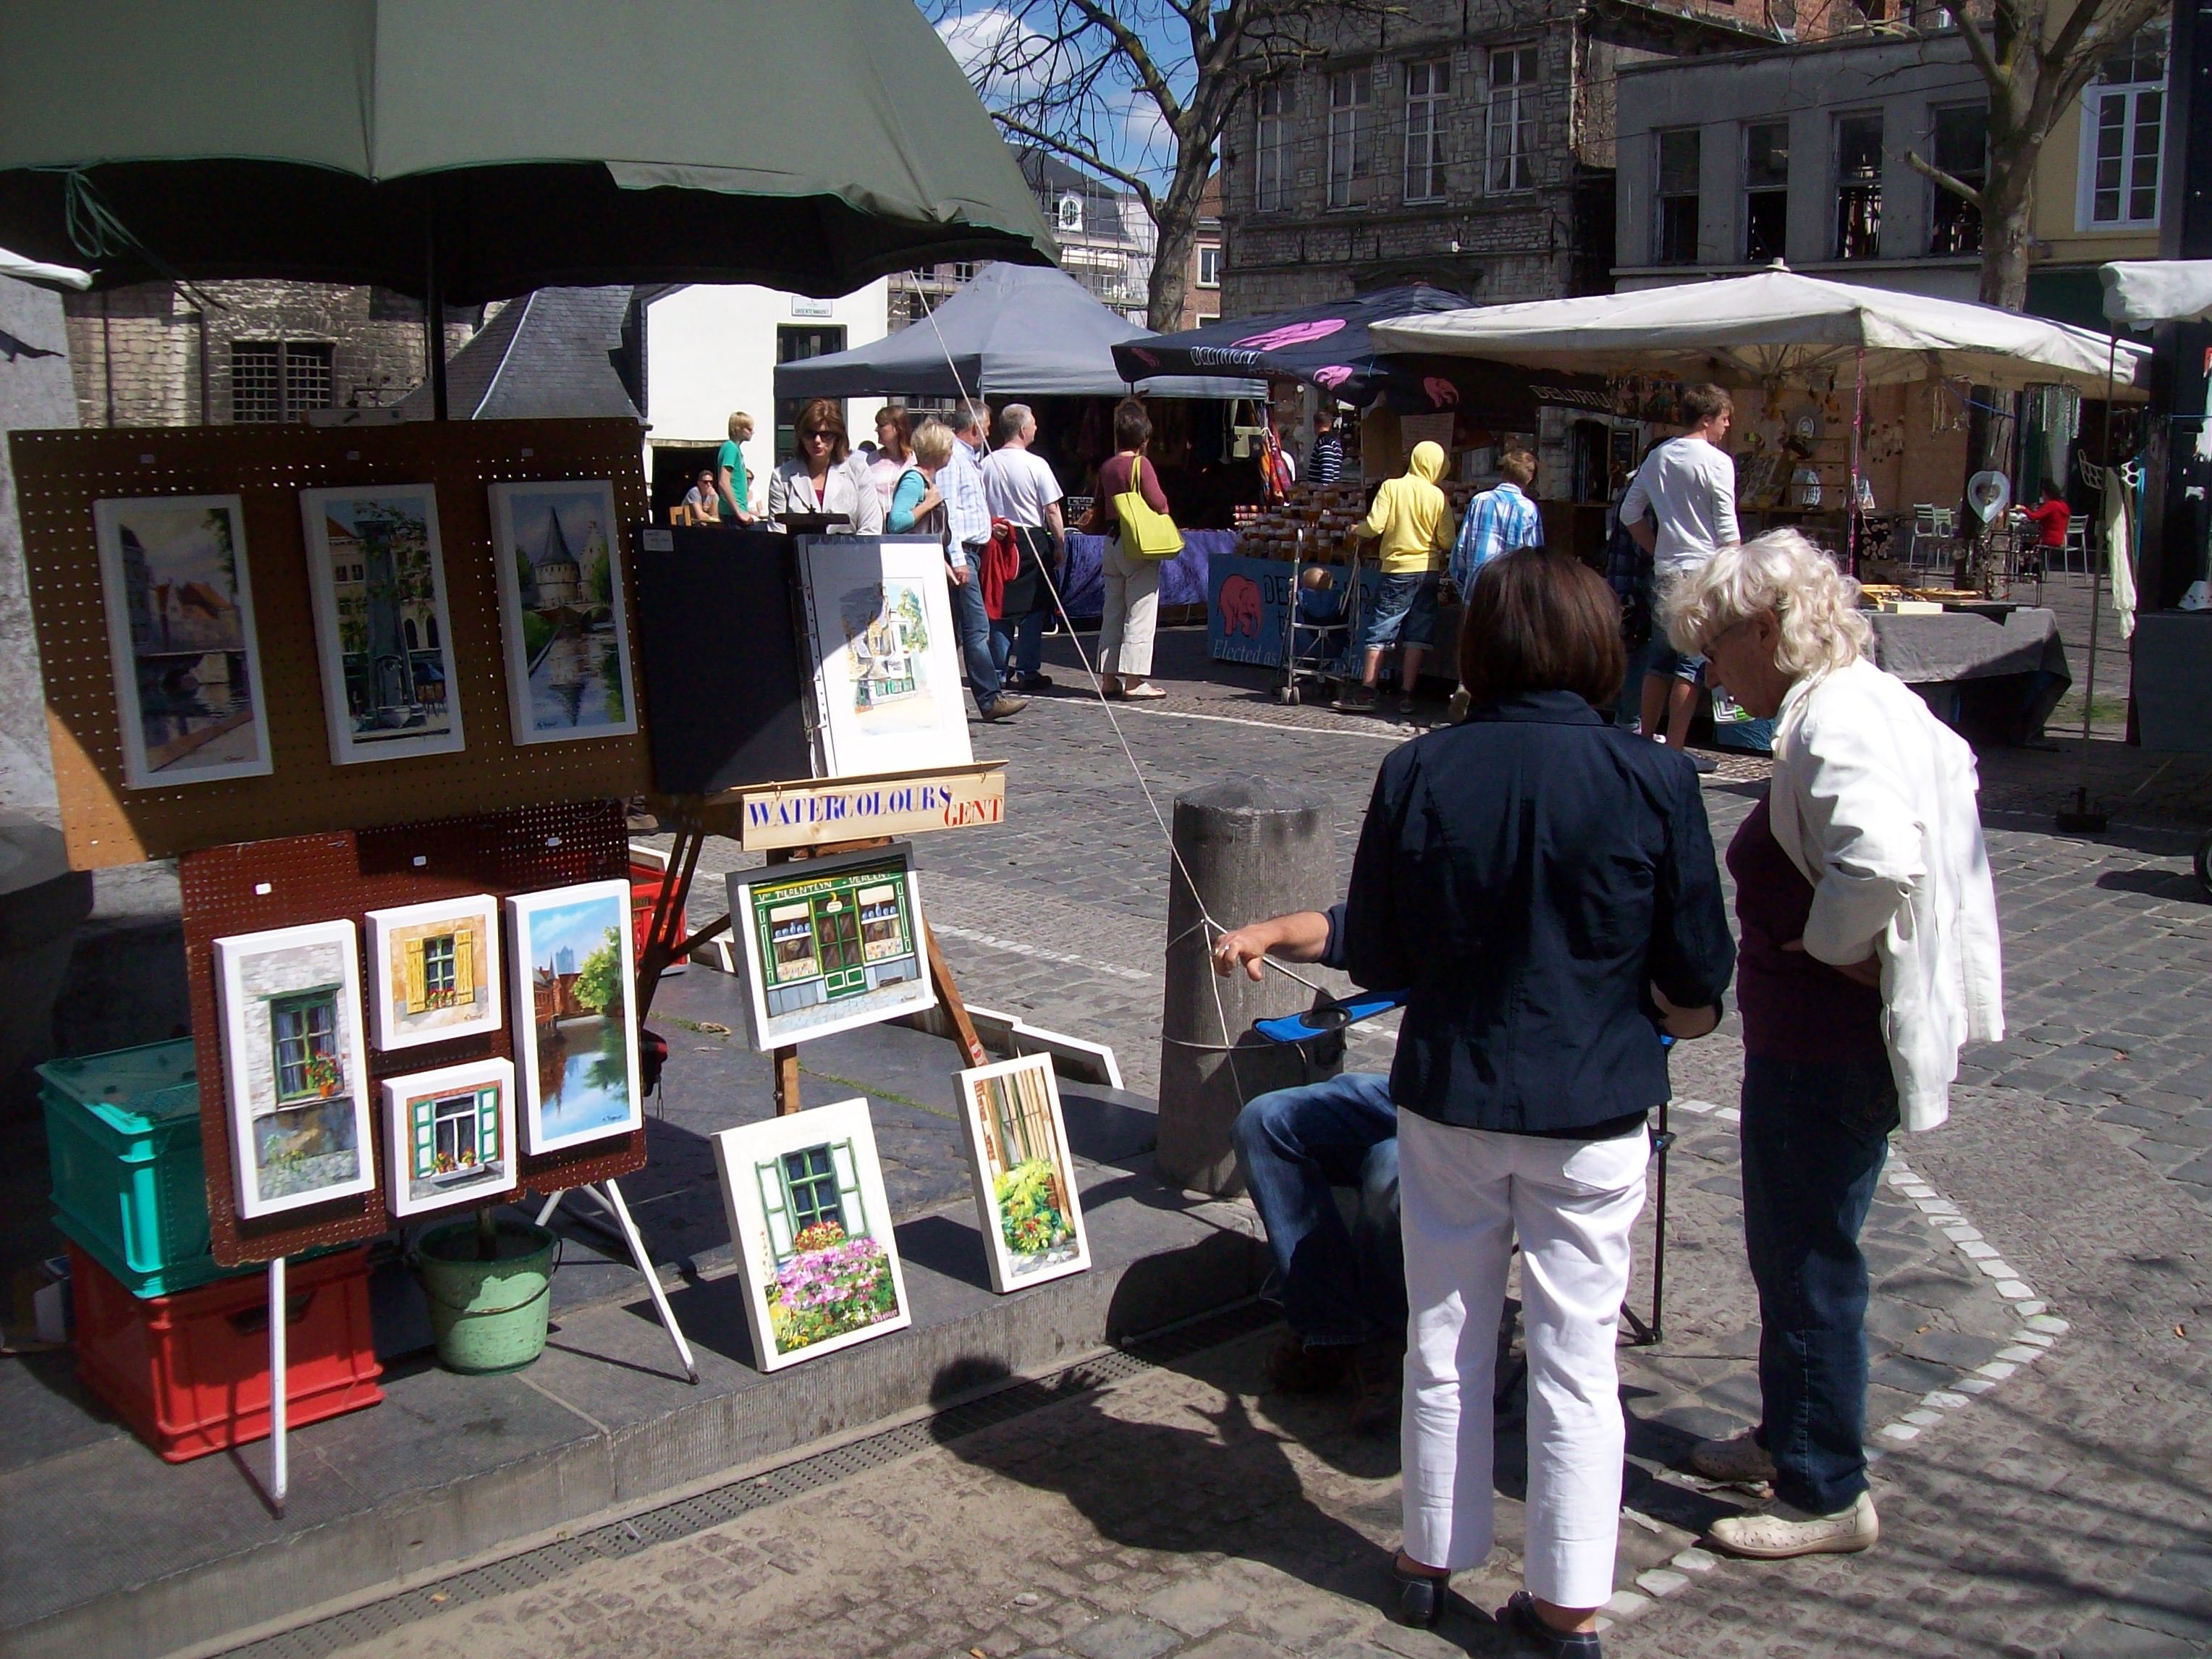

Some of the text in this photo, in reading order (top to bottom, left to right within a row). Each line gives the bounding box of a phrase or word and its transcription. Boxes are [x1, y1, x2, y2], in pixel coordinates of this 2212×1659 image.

[1529, 384, 1613, 409] DELIRIU
[1212, 638, 1262, 664] Elected
[748, 784, 953, 827] WATERCOLOURS
[943, 798, 1003, 827] GENT
